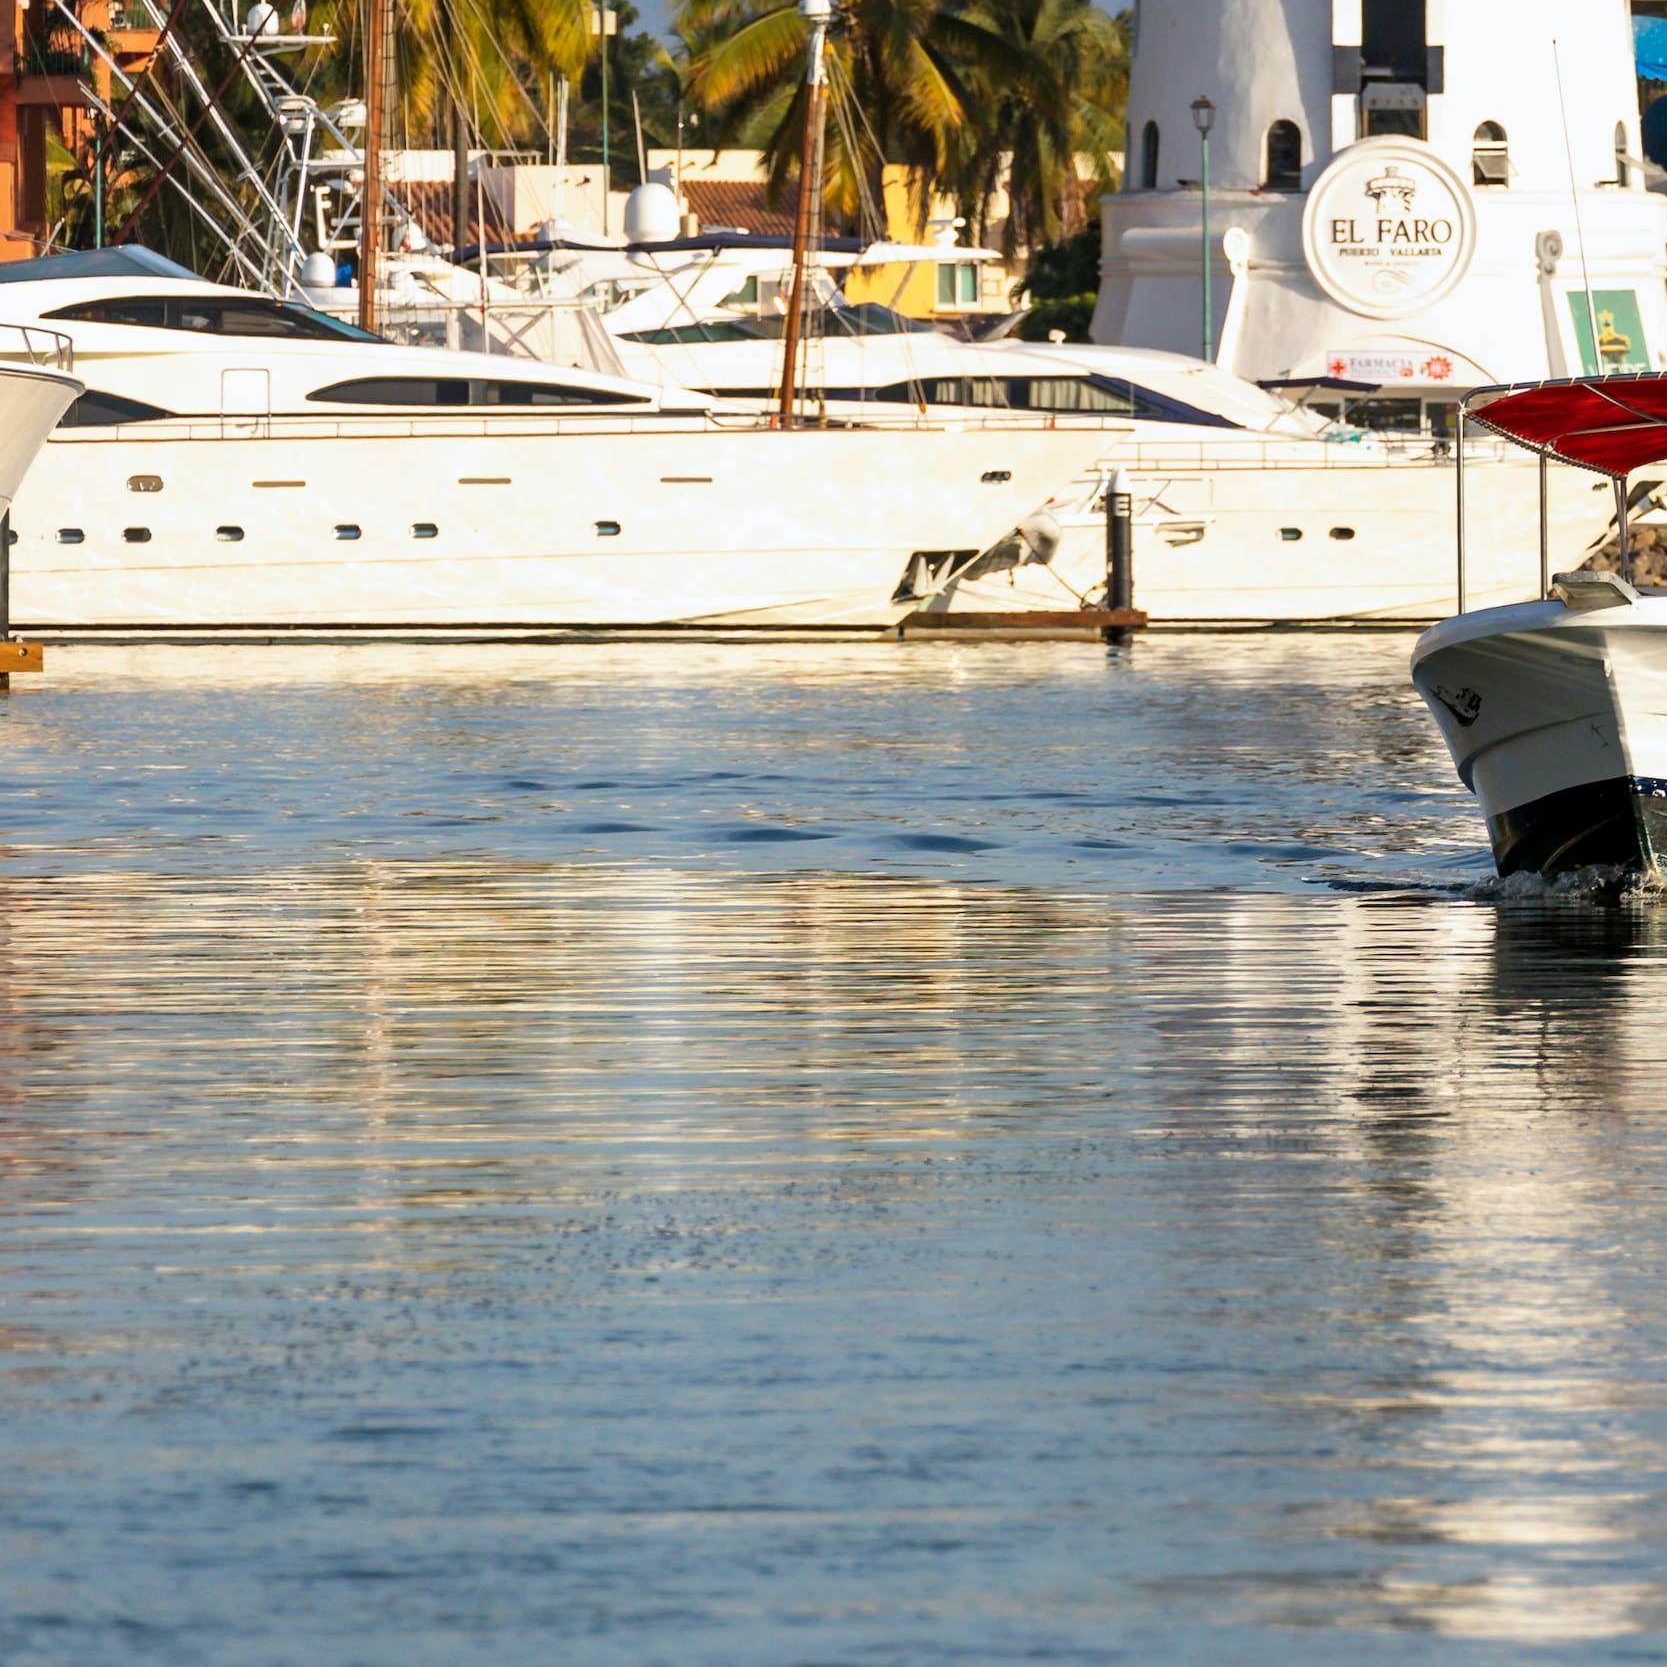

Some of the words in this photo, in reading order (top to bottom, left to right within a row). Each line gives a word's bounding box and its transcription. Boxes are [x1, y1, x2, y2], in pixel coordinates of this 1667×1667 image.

[1331, 219, 1364, 244] EL
[1377, 219, 1452, 244] FARO
[1339, 248, 1379, 257] PUERTO
[1390, 248, 1442, 257] VALLARTA
[1350, 358, 1414, 367] FARMACIA
